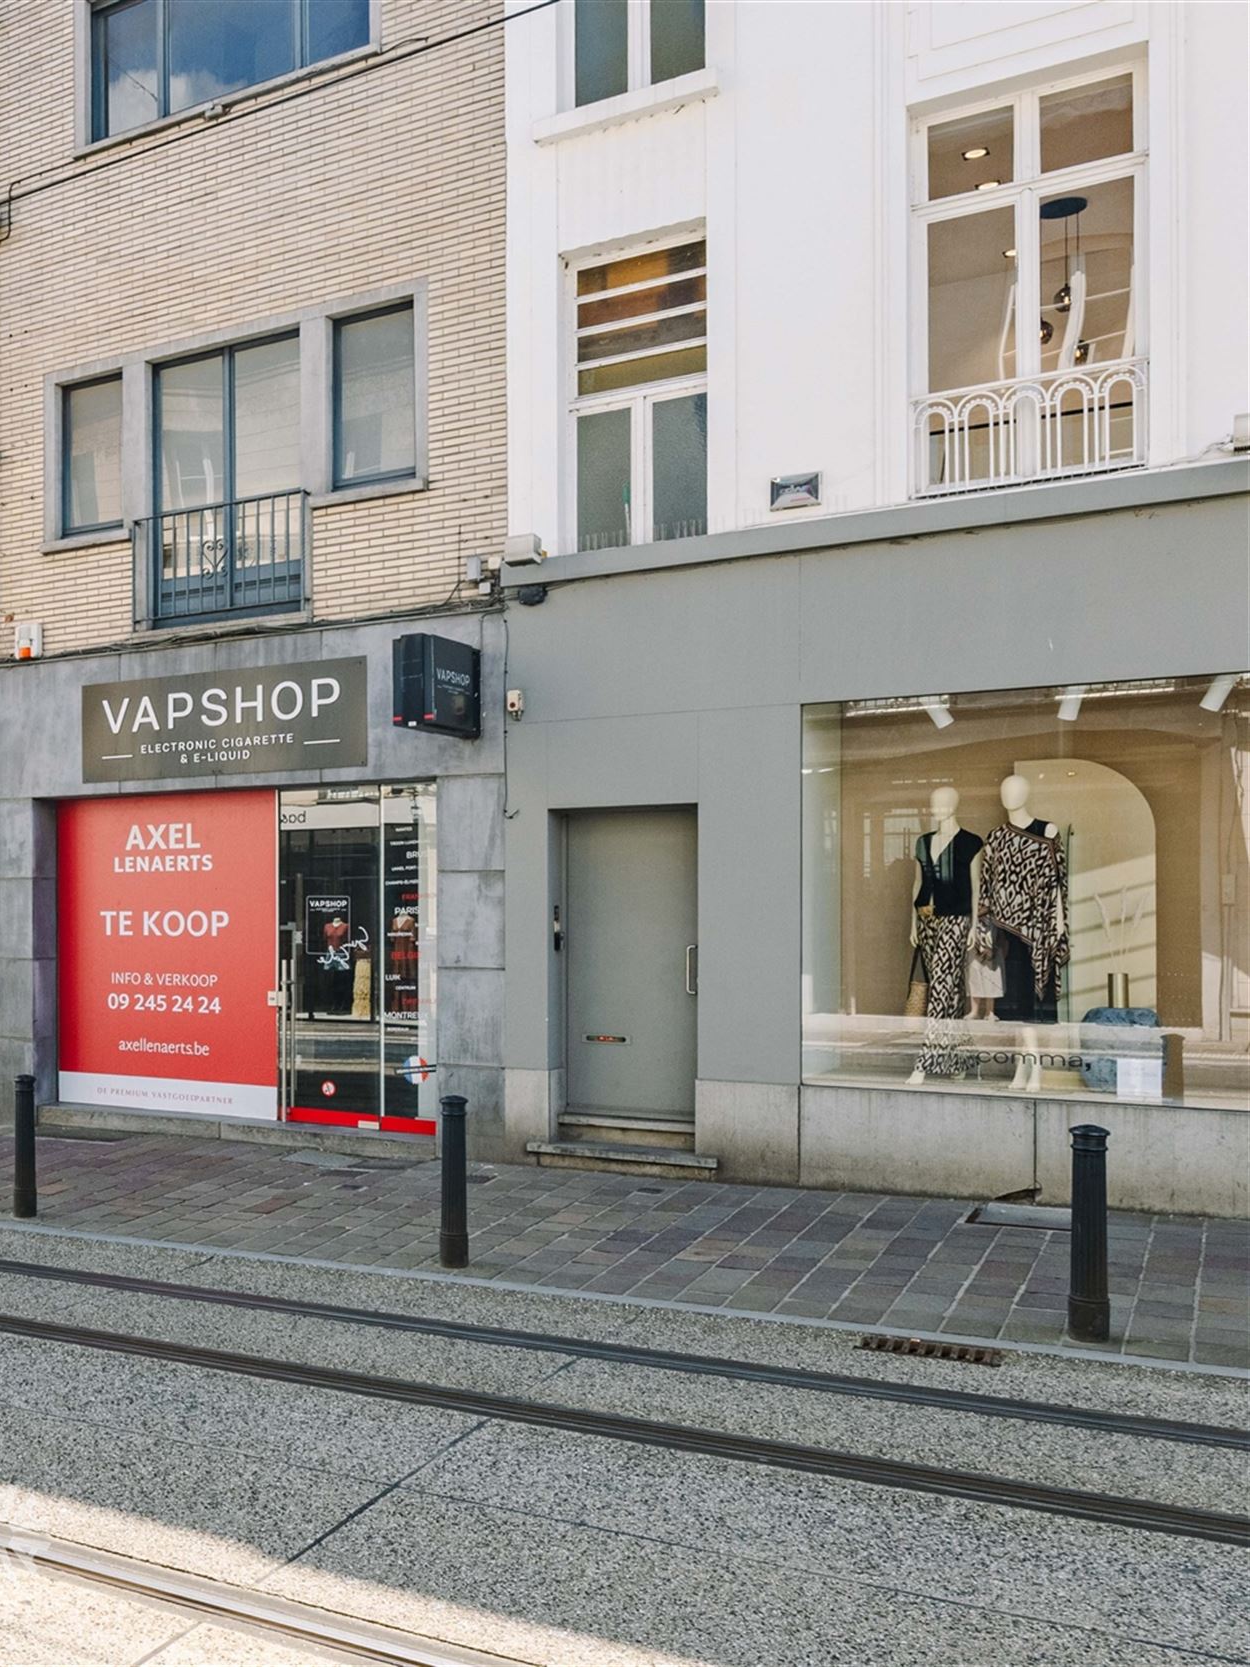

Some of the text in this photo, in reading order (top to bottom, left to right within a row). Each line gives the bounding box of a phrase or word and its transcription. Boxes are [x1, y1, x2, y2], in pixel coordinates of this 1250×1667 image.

[436, 667, 471, 686] VAPSHOP
[102, 677, 341, 734] VAPSHOP
[140, 733, 294, 754] ELECTRONIC CIGARETTE
[180, 750, 250, 764] & E-LIQUID
[125, 823, 201, 851] AXEL
[113, 854, 213, 873] LENAERTS
[309, 900, 348, 908] VAPSHOP
[394, 906, 421, 915] PARIS
[100, 910, 230, 937] TE KOOP
[111, 972, 218, 987] INFO & VERKOOP
[107, 993, 221, 1014] 09 245 24 24
[118, 1038, 210, 1056] axellenaerts.be
[110, 1088, 149, 1098] PREMIUM
[151, 1091, 233, 1104] VASTGOEDPARTNER
